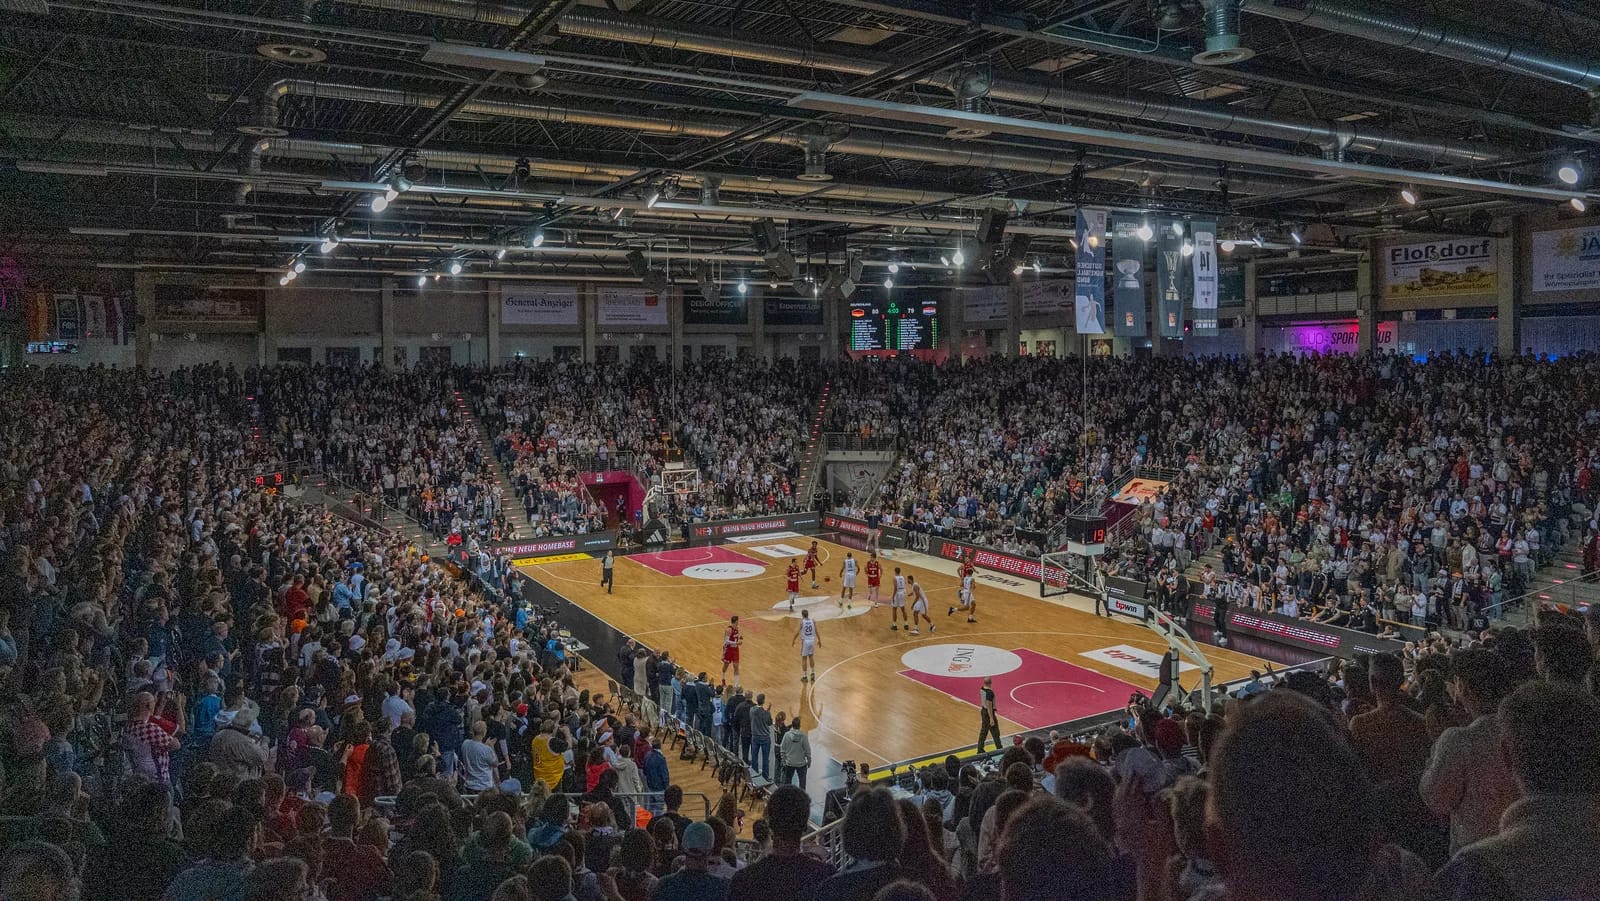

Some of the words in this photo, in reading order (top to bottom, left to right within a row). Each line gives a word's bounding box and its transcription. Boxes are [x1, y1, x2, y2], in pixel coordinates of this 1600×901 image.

[1391, 240, 1490, 261] Floßdorf
[1093, 529, 1105, 542] 19
[518, 544, 537, 553] NEUE
[538, 541, 574, 551] HOMEBASE
[976, 552, 998, 567] DEINE
[999, 557, 1022, 573] NEUE
[1022, 562, 1070, 584] HOMEBASE
[1115, 600, 1137, 613] tipwin
[804, 625, 813, 633] 20
[952, 647, 975, 662] ING
